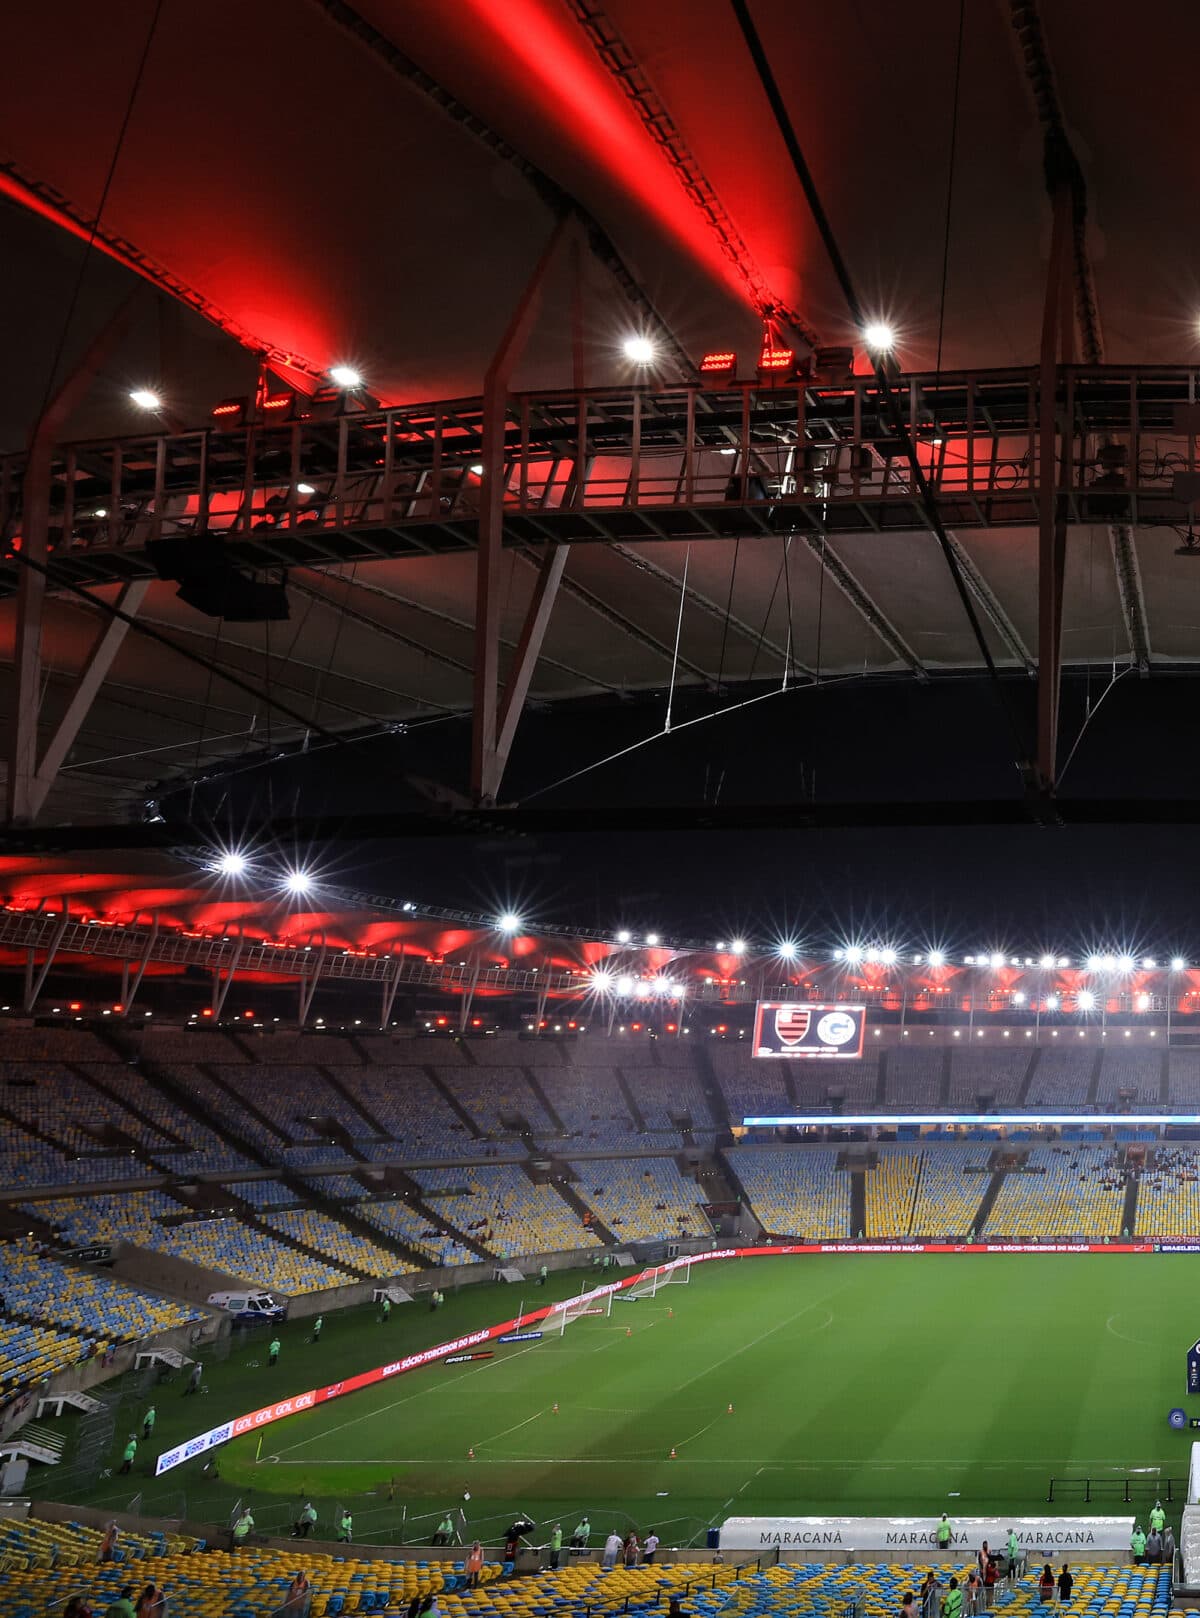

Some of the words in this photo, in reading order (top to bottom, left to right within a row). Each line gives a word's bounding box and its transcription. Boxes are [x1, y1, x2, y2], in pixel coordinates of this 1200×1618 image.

[383, 1362, 400, 1376] SEJA
[469, 1330, 489, 1344] NAÇÃO
[236, 1417, 253, 1432] GOL
[255, 1409, 272, 1424] GOL
[275, 1402, 292, 1416] GOL
[295, 1394, 312, 1409] GOL
[886, 1531, 969, 1544] MARACNÃ
